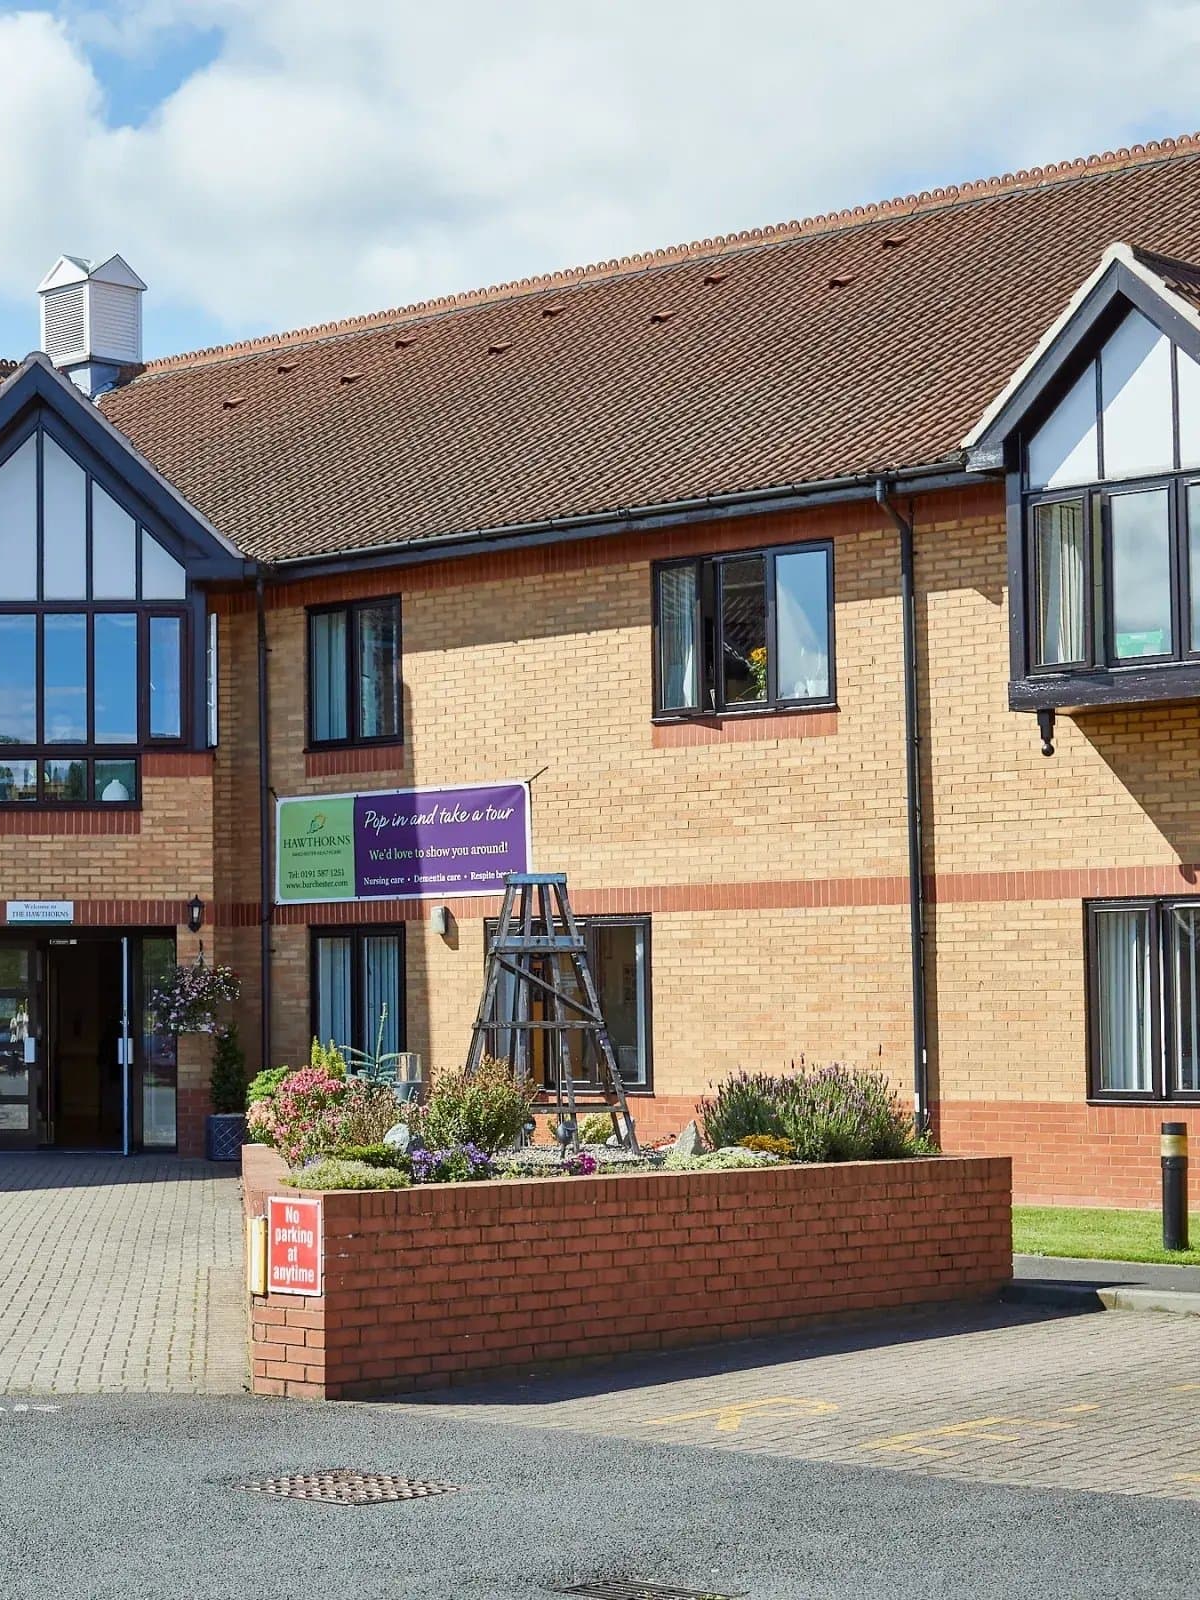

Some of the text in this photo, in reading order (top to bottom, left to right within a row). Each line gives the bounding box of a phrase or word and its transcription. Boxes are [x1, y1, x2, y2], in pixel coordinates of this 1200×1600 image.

[364, 803, 514, 836] Pop in and take a tour
[283, 835, 351, 848] HAWTHORNS
[369, 841, 508, 860] We'd love to show you around!
[364, 876, 390, 886] Nursing
[414, 873, 446, 882] Dementia
[470, 871, 495, 882] Respite
[285, 1206, 299, 1224] No
[275, 1226, 313, 1248] parking
[288, 1246, 298, 1262] at
[273, 1265, 314, 1284] anytime
